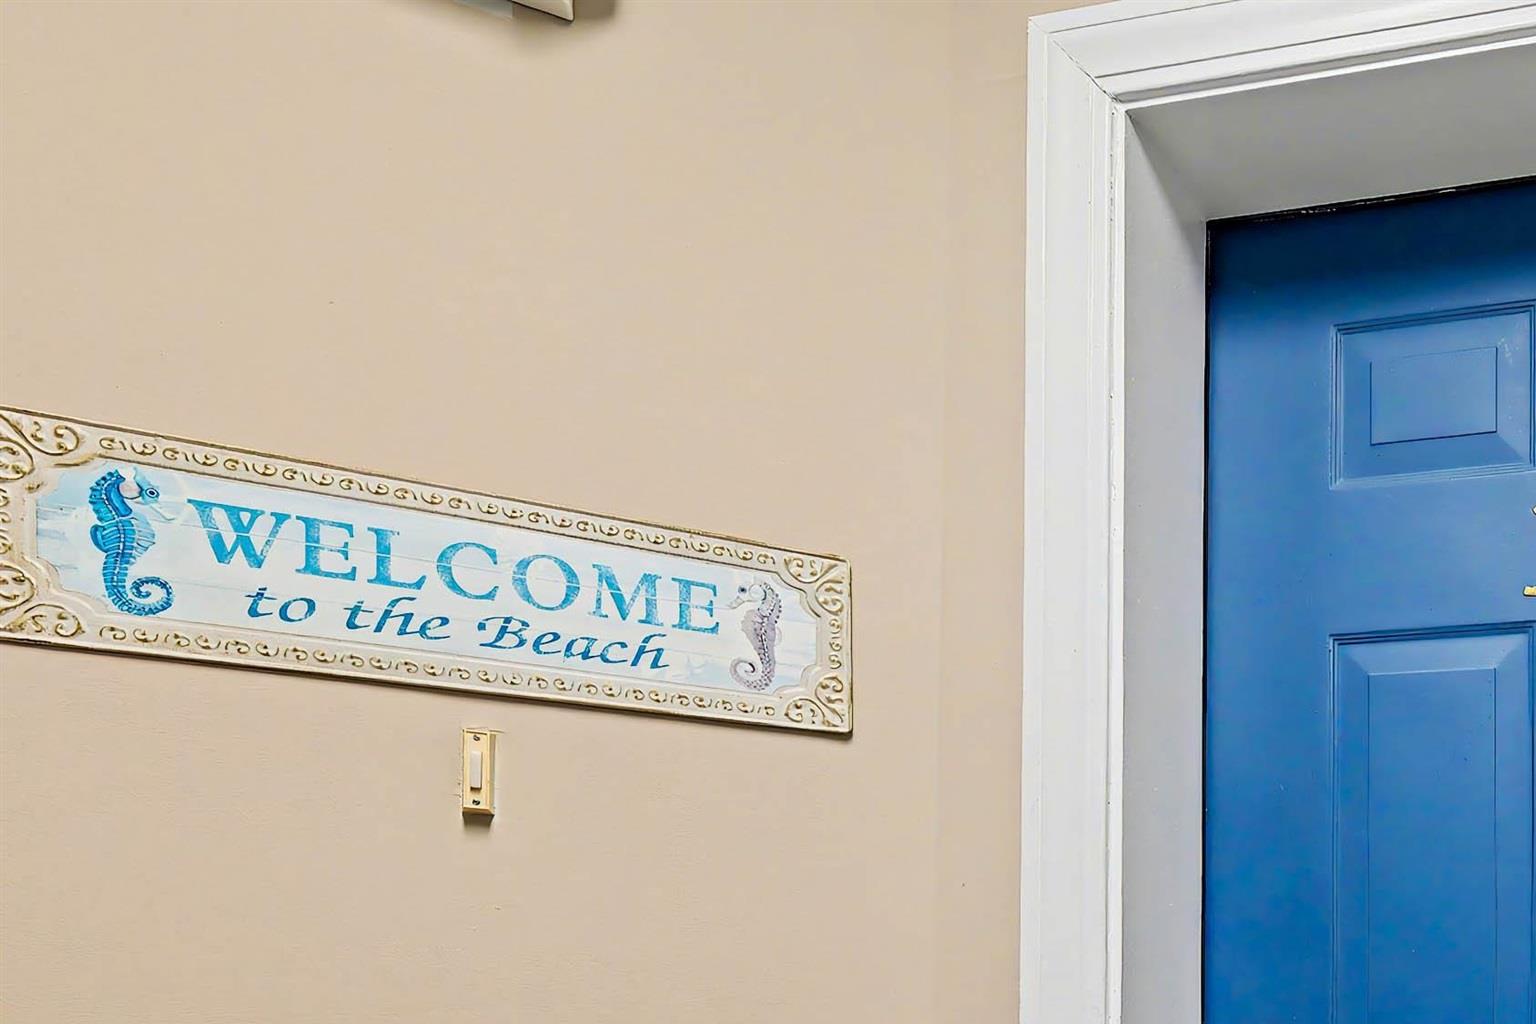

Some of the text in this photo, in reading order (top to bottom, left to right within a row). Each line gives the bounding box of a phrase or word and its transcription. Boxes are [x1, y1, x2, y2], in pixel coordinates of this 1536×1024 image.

[187, 498, 721, 636] WELCOME
[245, 586, 671, 670] to the Beach
